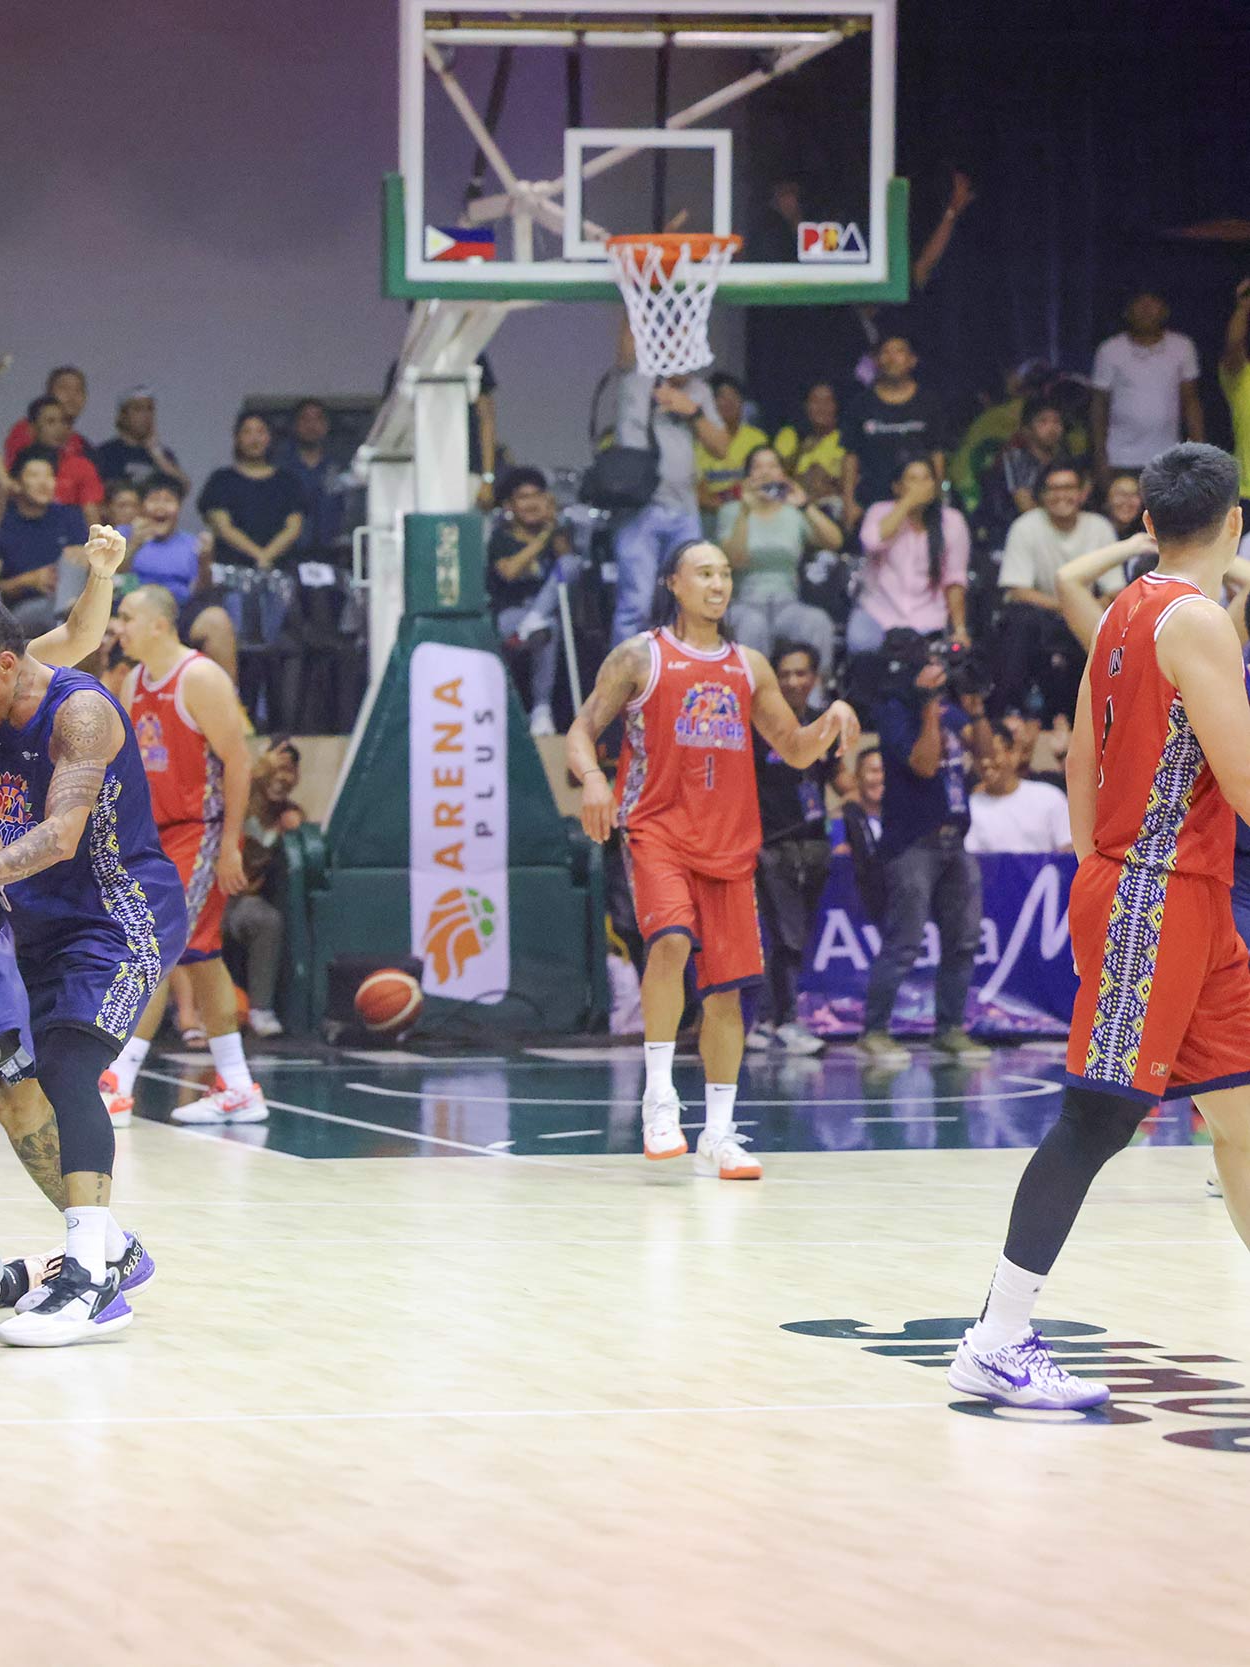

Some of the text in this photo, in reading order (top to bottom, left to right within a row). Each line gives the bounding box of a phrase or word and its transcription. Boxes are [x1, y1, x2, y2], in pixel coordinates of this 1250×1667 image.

[433, 678, 464, 873] ARENA
[475, 708, 495, 837] PLUS
[779, 1316, 1250, 1453] Sting
